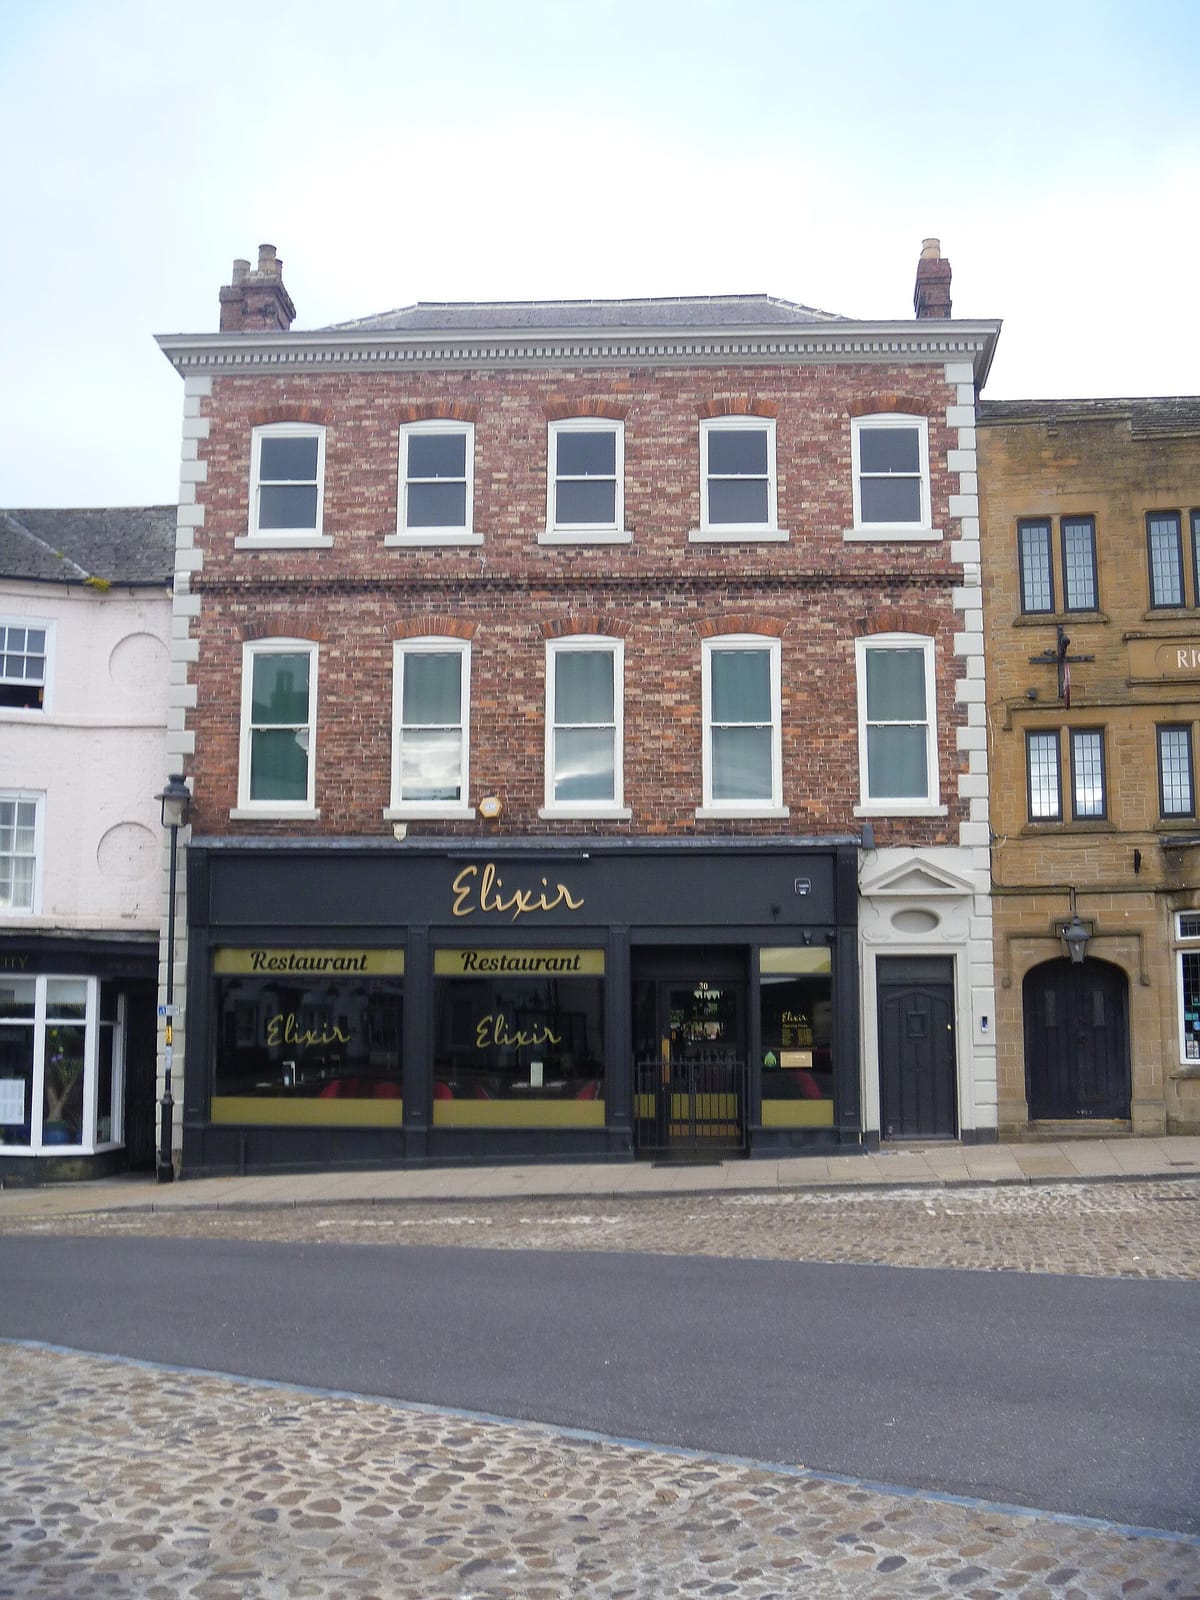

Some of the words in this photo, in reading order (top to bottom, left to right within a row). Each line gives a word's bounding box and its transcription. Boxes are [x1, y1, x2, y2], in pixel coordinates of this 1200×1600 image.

[452, 863, 584, 921] Elixir
[251, 951, 368, 972] Restaurant
[461, 951, 580, 972] Restaurant
[267, 1013, 351, 1048] Elixir
[476, 1015, 562, 1049] Elixir
